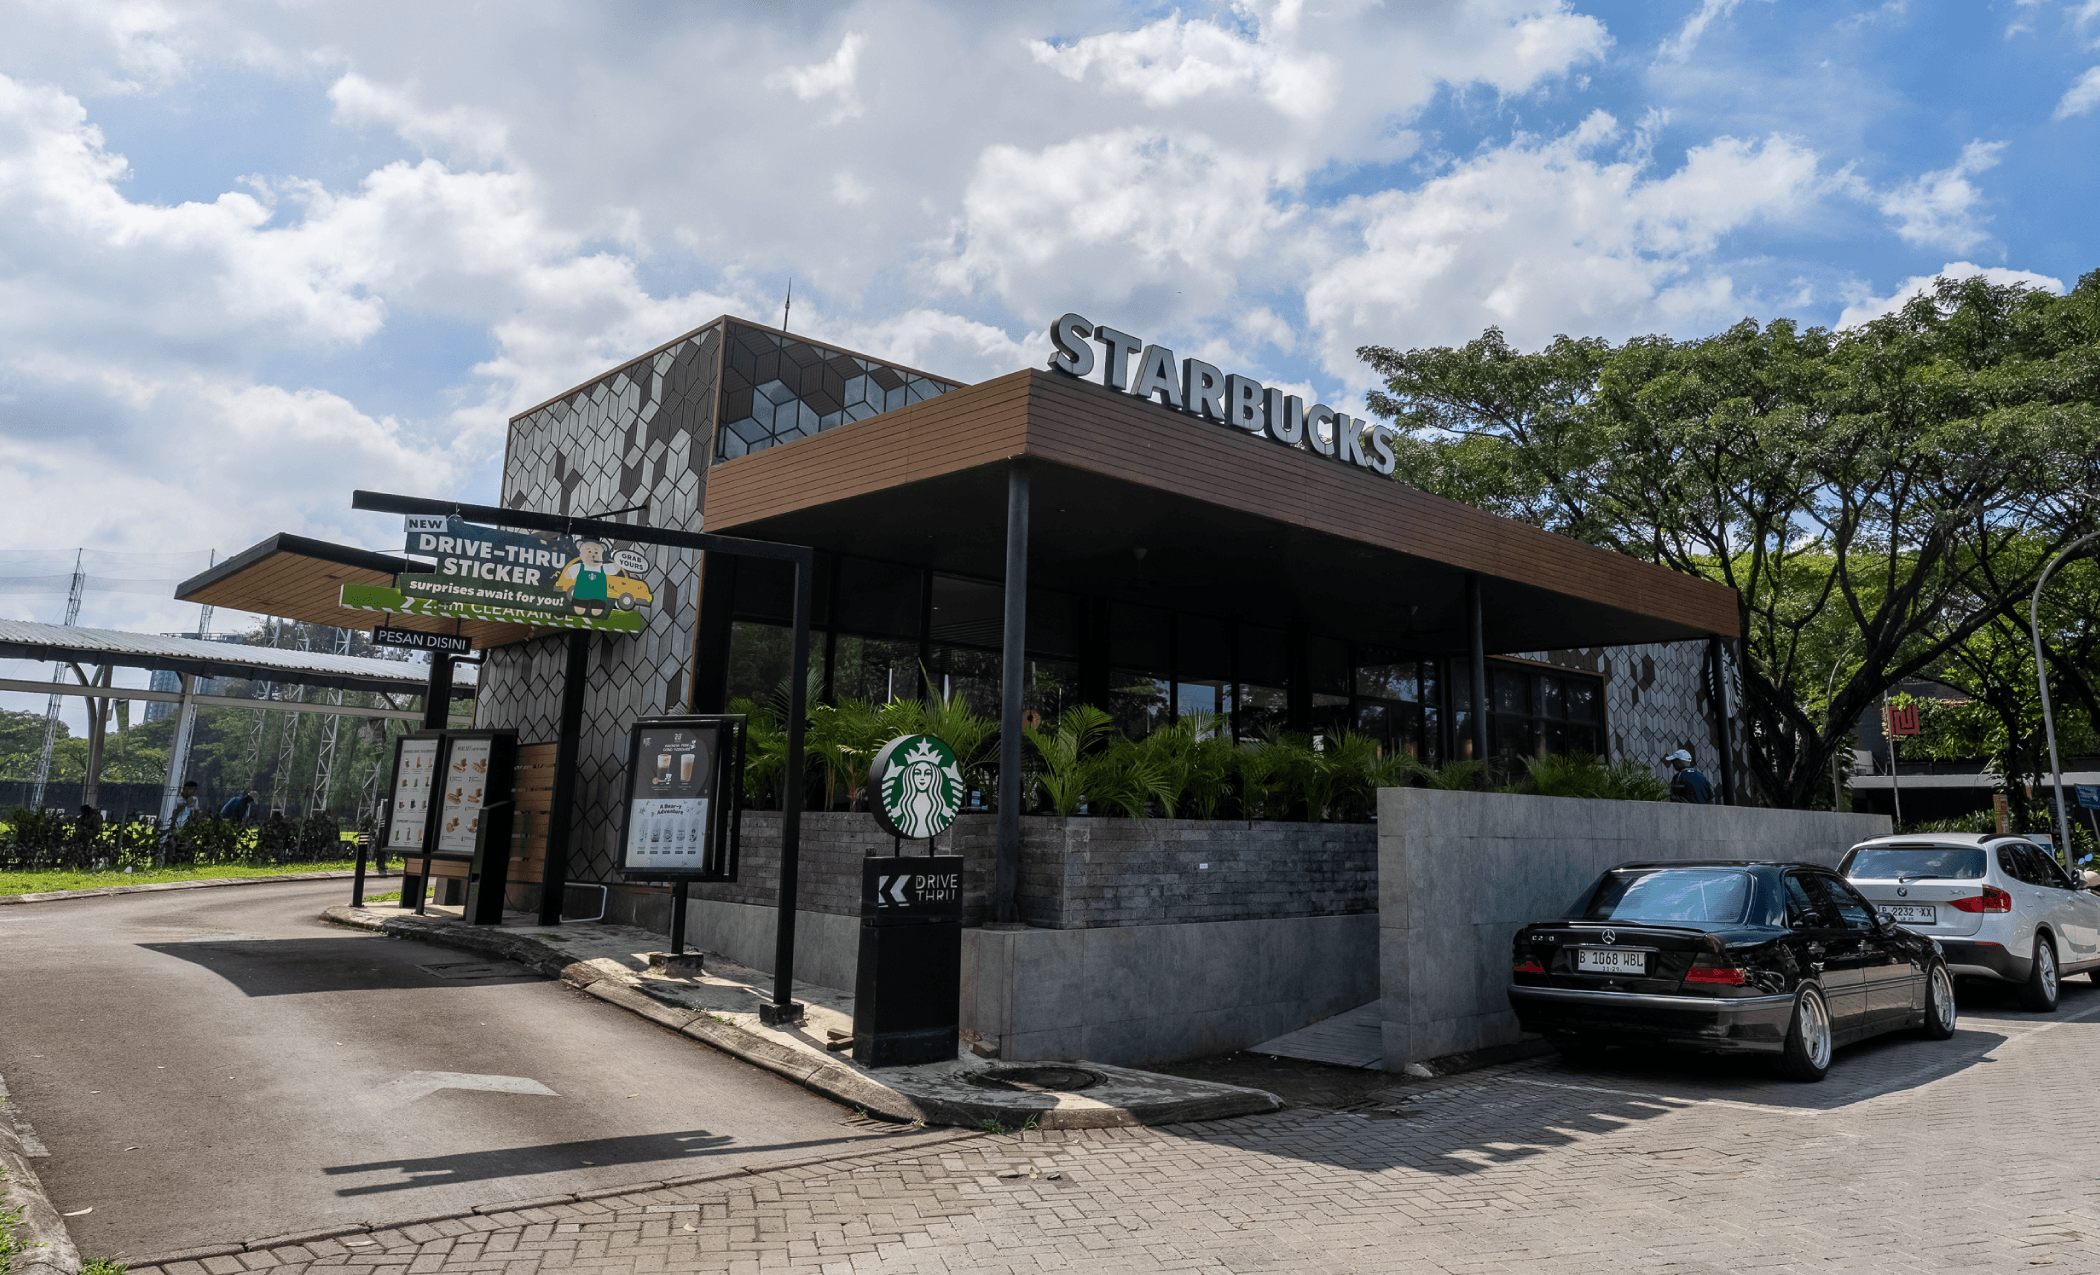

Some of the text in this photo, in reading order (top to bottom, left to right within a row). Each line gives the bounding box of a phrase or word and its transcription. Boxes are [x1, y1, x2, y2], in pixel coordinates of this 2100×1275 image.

[1047, 312, 1396, 476] STARBUCKS
[408, 519, 443, 529] NEW
[419, 533, 566, 569] DRIVE-THRU
[621, 553, 642, 563] GRAB
[442, 557, 541, 586] STICKER
[619, 559, 643, 570] YOURS
[409, 580, 564, 607] surprises await for you!
[377, 630, 466, 651] PESAN DISINI
[915, 873, 958, 889] DRIVE
[1892, 907, 1914, 917] 2232
[1579, 951, 1643, 967] B 1068 WBL
